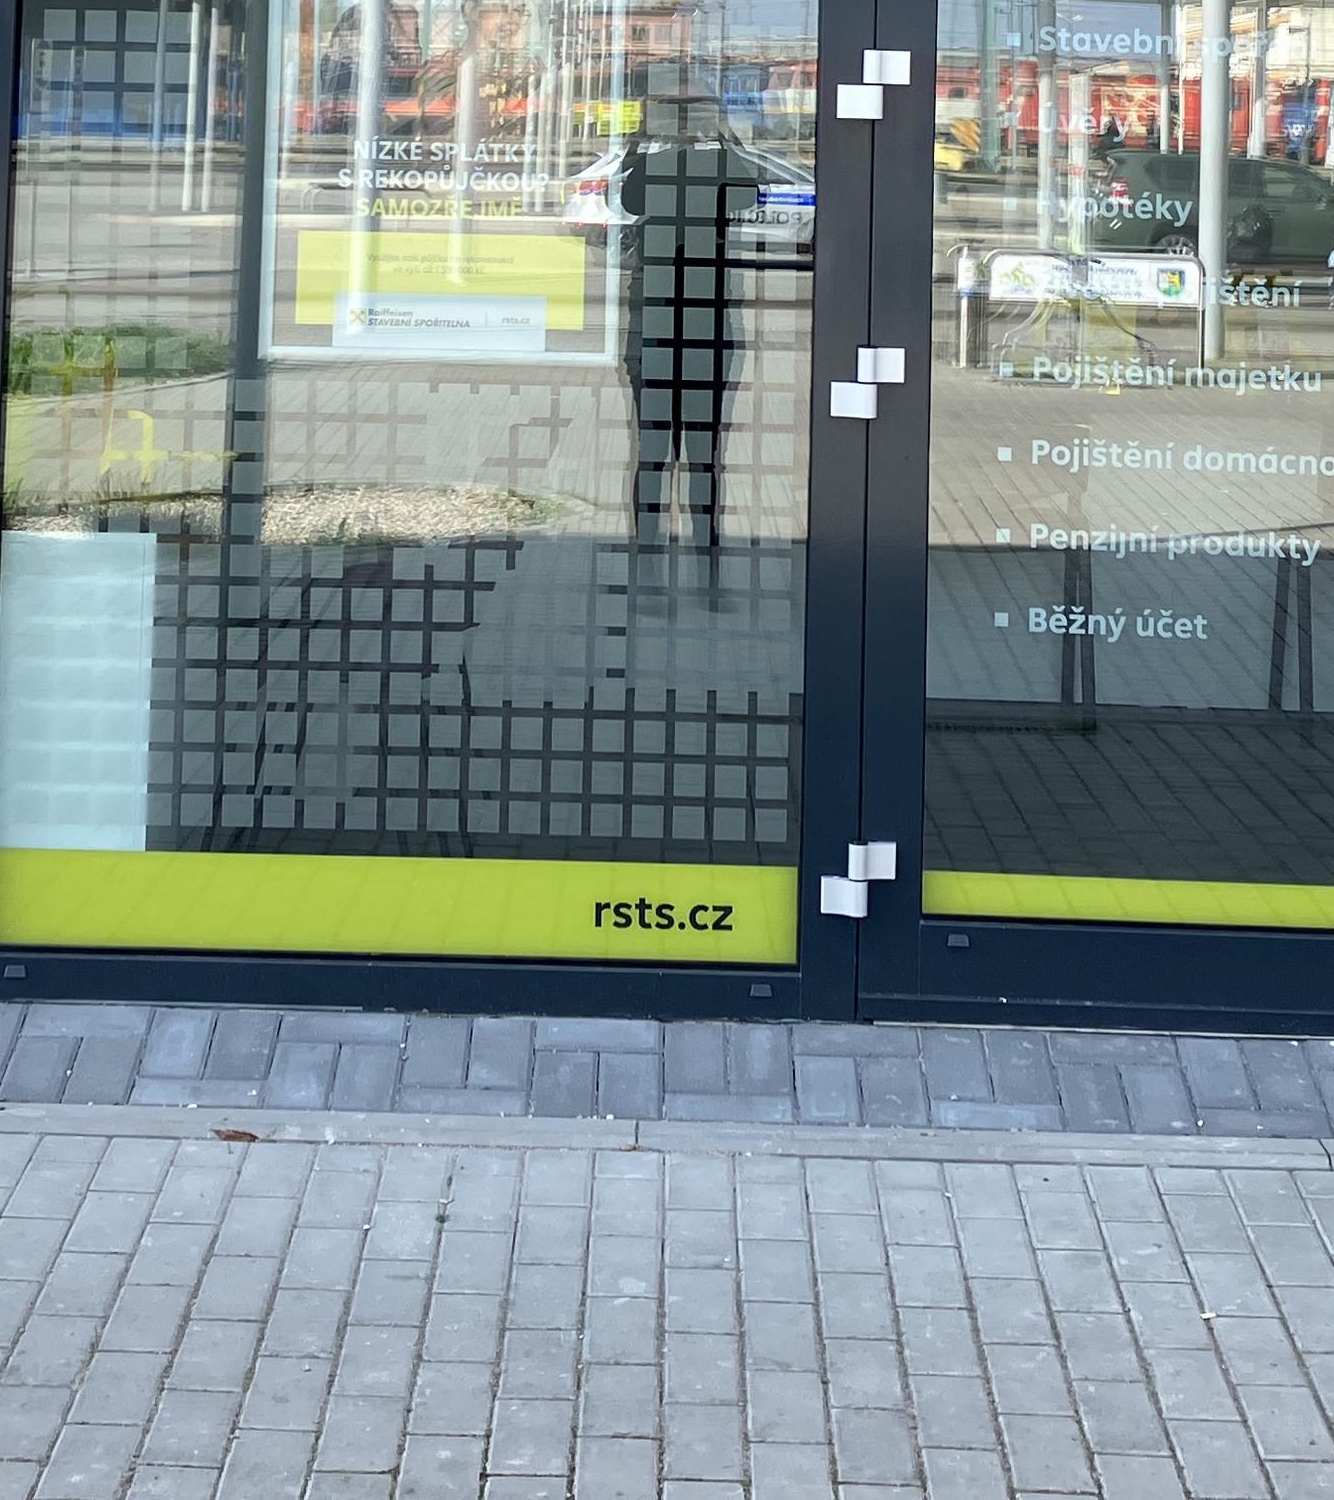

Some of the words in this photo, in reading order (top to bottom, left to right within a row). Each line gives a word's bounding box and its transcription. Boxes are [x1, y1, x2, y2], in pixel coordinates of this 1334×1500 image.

[1039, 25, 1178, 54] Stavebn
[353, 137, 422, 162] NÍZKÉ
[430, 138, 537, 163] SPLÁTKY
[338, 168, 353, 188] S
[1205, 274, 1302, 307] ištění
[1033, 355, 1175, 389] Pojištění
[1185, 363, 1322, 397] majetku
[1030, 439, 1173, 476] Pojištění
[1030, 523, 1158, 560] Penzijní
[1168, 530, 1321, 567] produkty
[1028, 605, 1128, 643] Běžný
[1137, 609, 1208, 640] účet
[594, 897, 734, 931] rsts.cz
